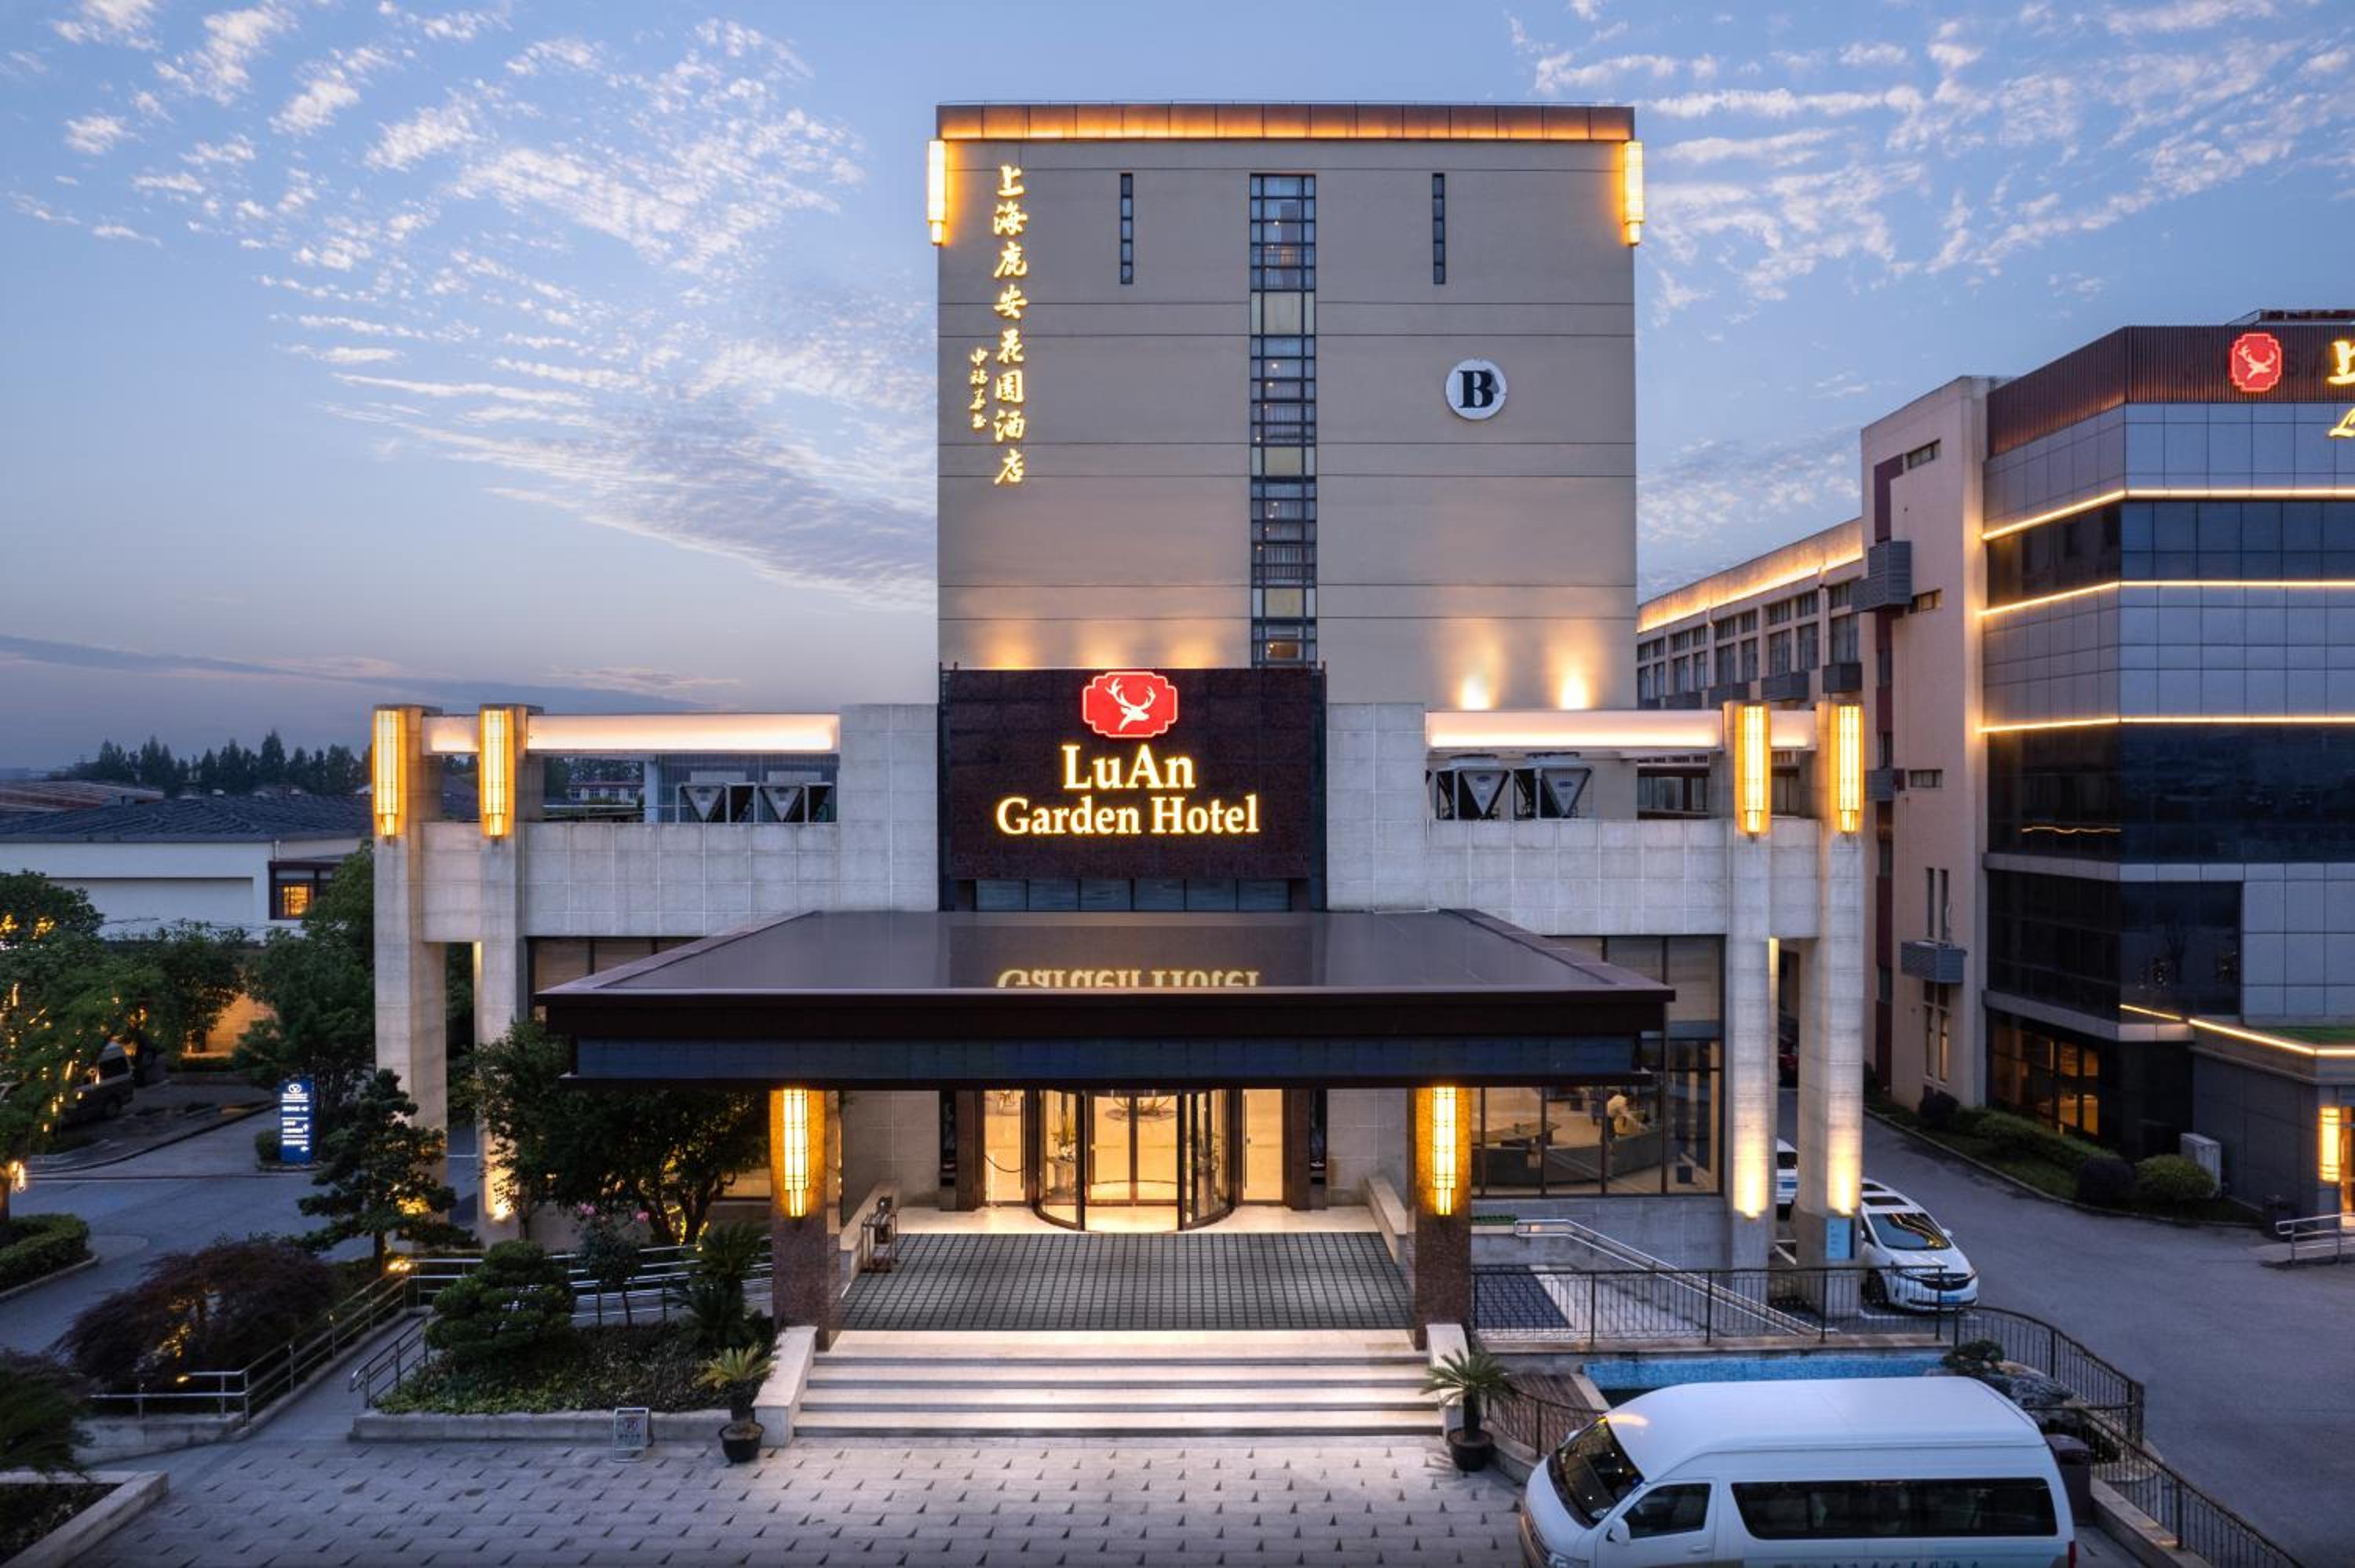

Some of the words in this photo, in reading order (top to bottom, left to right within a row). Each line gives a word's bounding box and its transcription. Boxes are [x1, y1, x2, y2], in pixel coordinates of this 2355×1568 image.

[1458, 370, 1495, 409] B
[1062, 744, 1196, 789] LuAn
[996, 795, 1142, 835] Garden
[1150, 794, 1260, 834] Hotel
